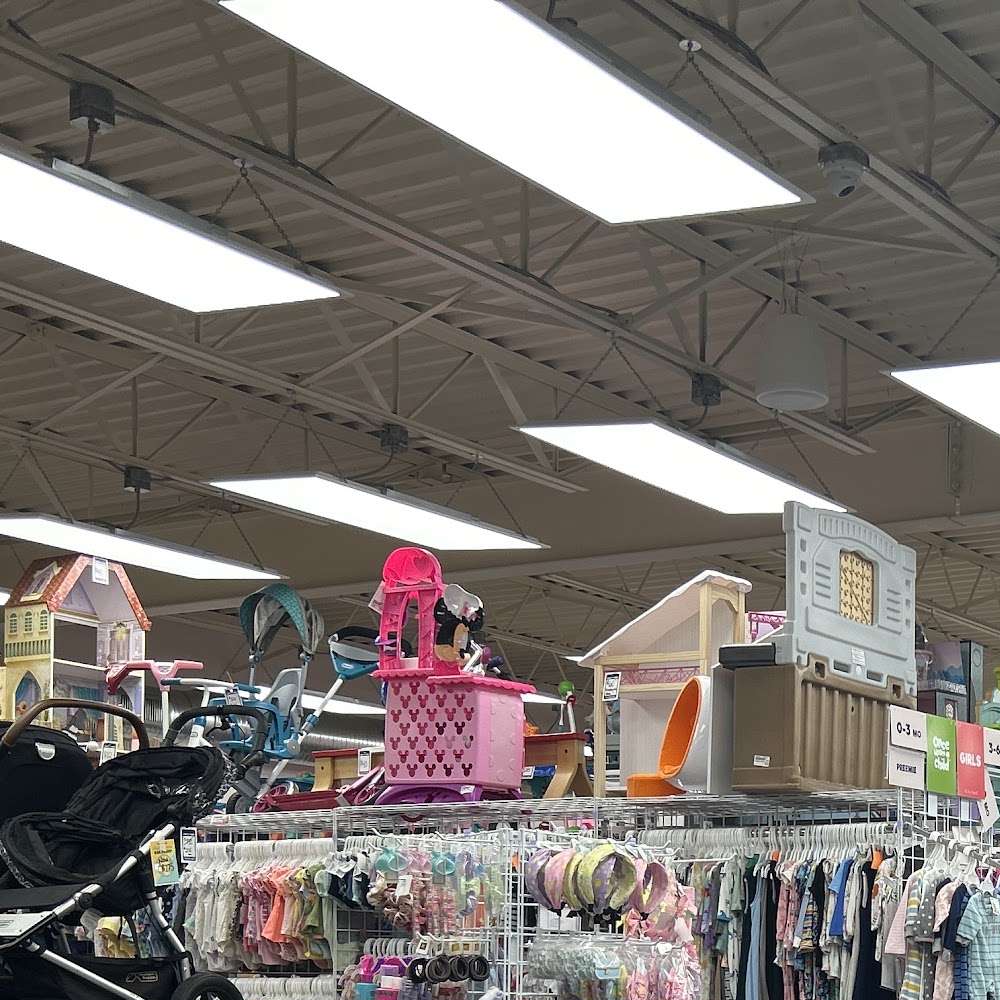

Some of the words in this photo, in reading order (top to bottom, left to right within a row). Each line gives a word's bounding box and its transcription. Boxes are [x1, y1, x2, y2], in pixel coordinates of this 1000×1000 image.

[896, 722, 911, 736] 0-3
[912, 729, 922, 738] MO
[988, 742, 1000, 756] 3-6
[959, 752, 982, 768] GIRLS
